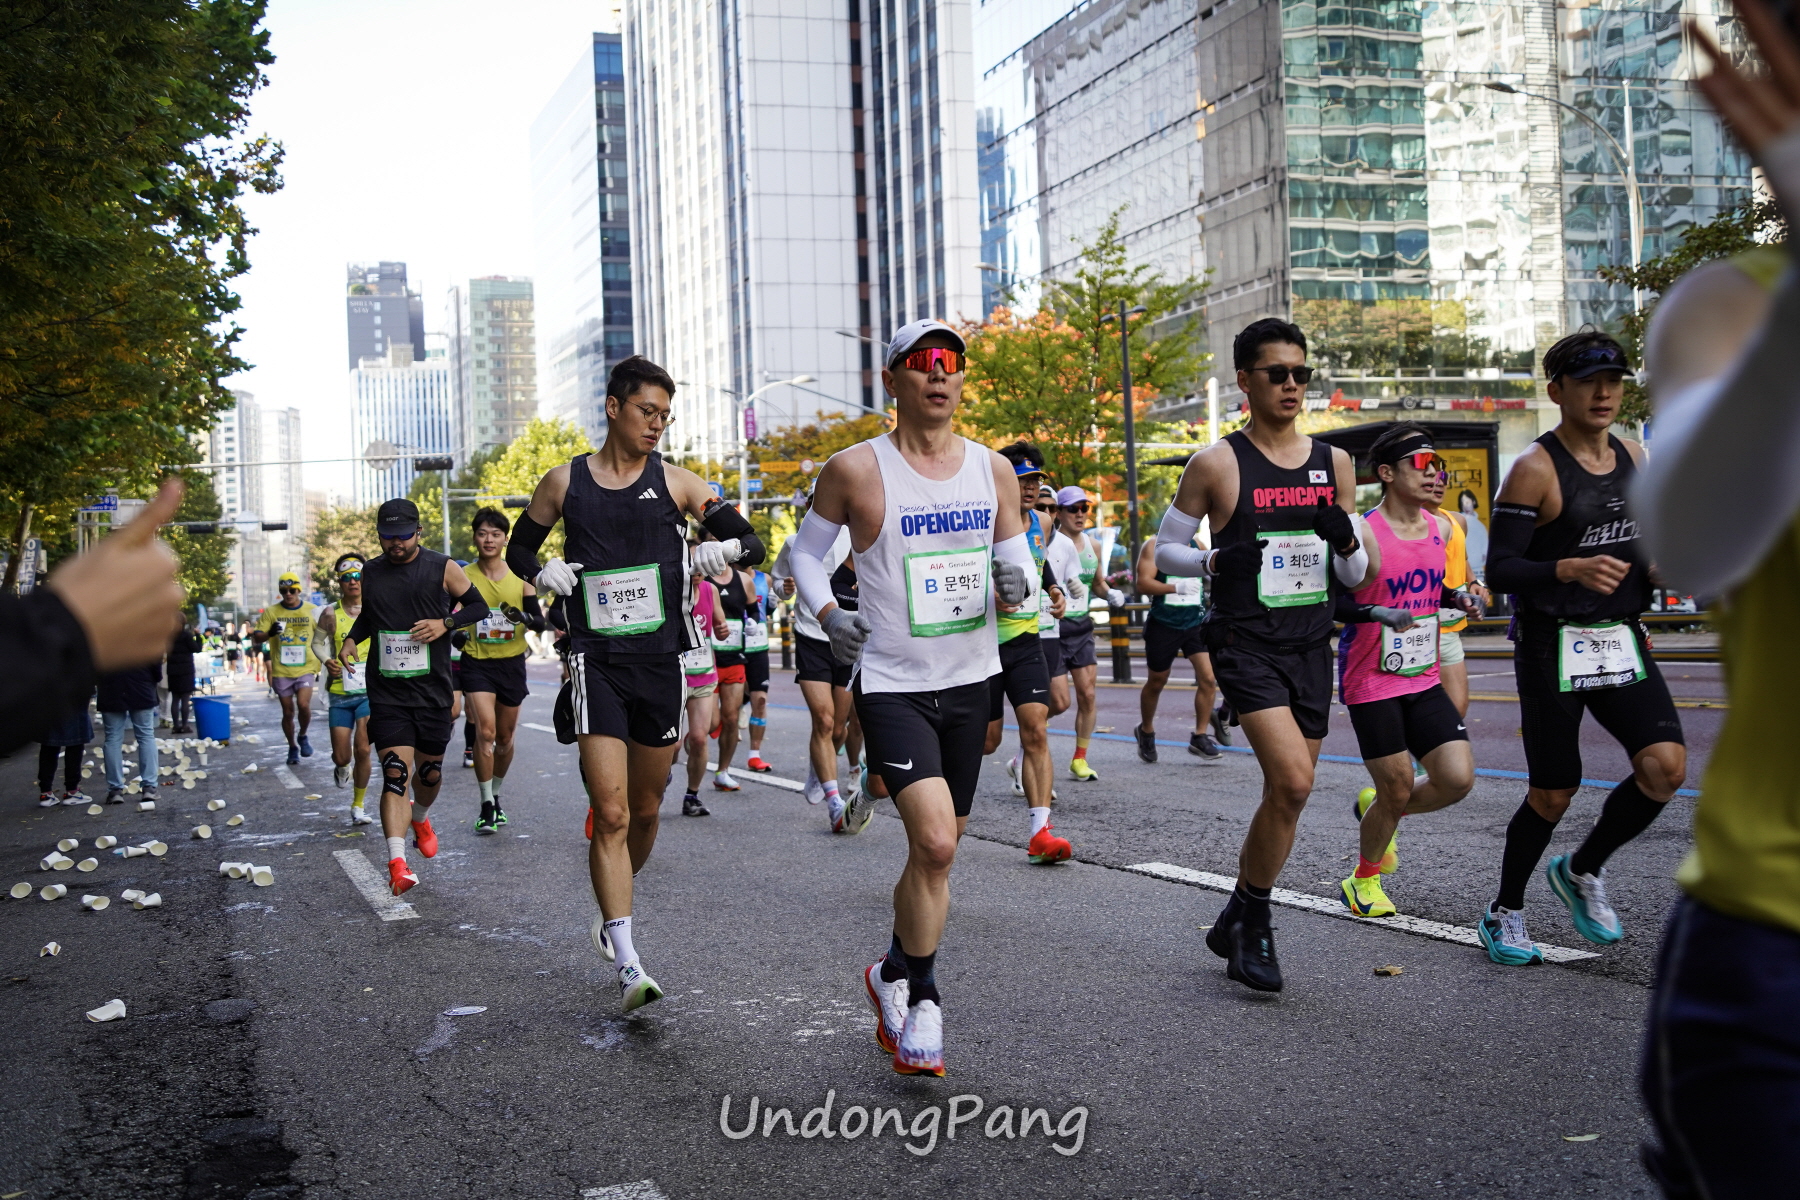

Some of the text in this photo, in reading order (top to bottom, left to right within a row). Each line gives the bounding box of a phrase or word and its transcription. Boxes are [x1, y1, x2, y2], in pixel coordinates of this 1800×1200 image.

[898, 499, 991, 513] Design Your Running
[900, 508, 992, 537] OPENCARE
[929, 560, 977, 571] AIA Genabelle
[1272, 552, 1320, 570] B 최인호
[924, 572, 981, 594] B 문학진
[1385, 568, 1445, 600] WOW
[597, 586, 649, 605] B 정현호
[385, 644, 420, 655] B 이재형
[1393, 632, 1432, 650] B 이원석
[1572, 640, 1585, 654] C
